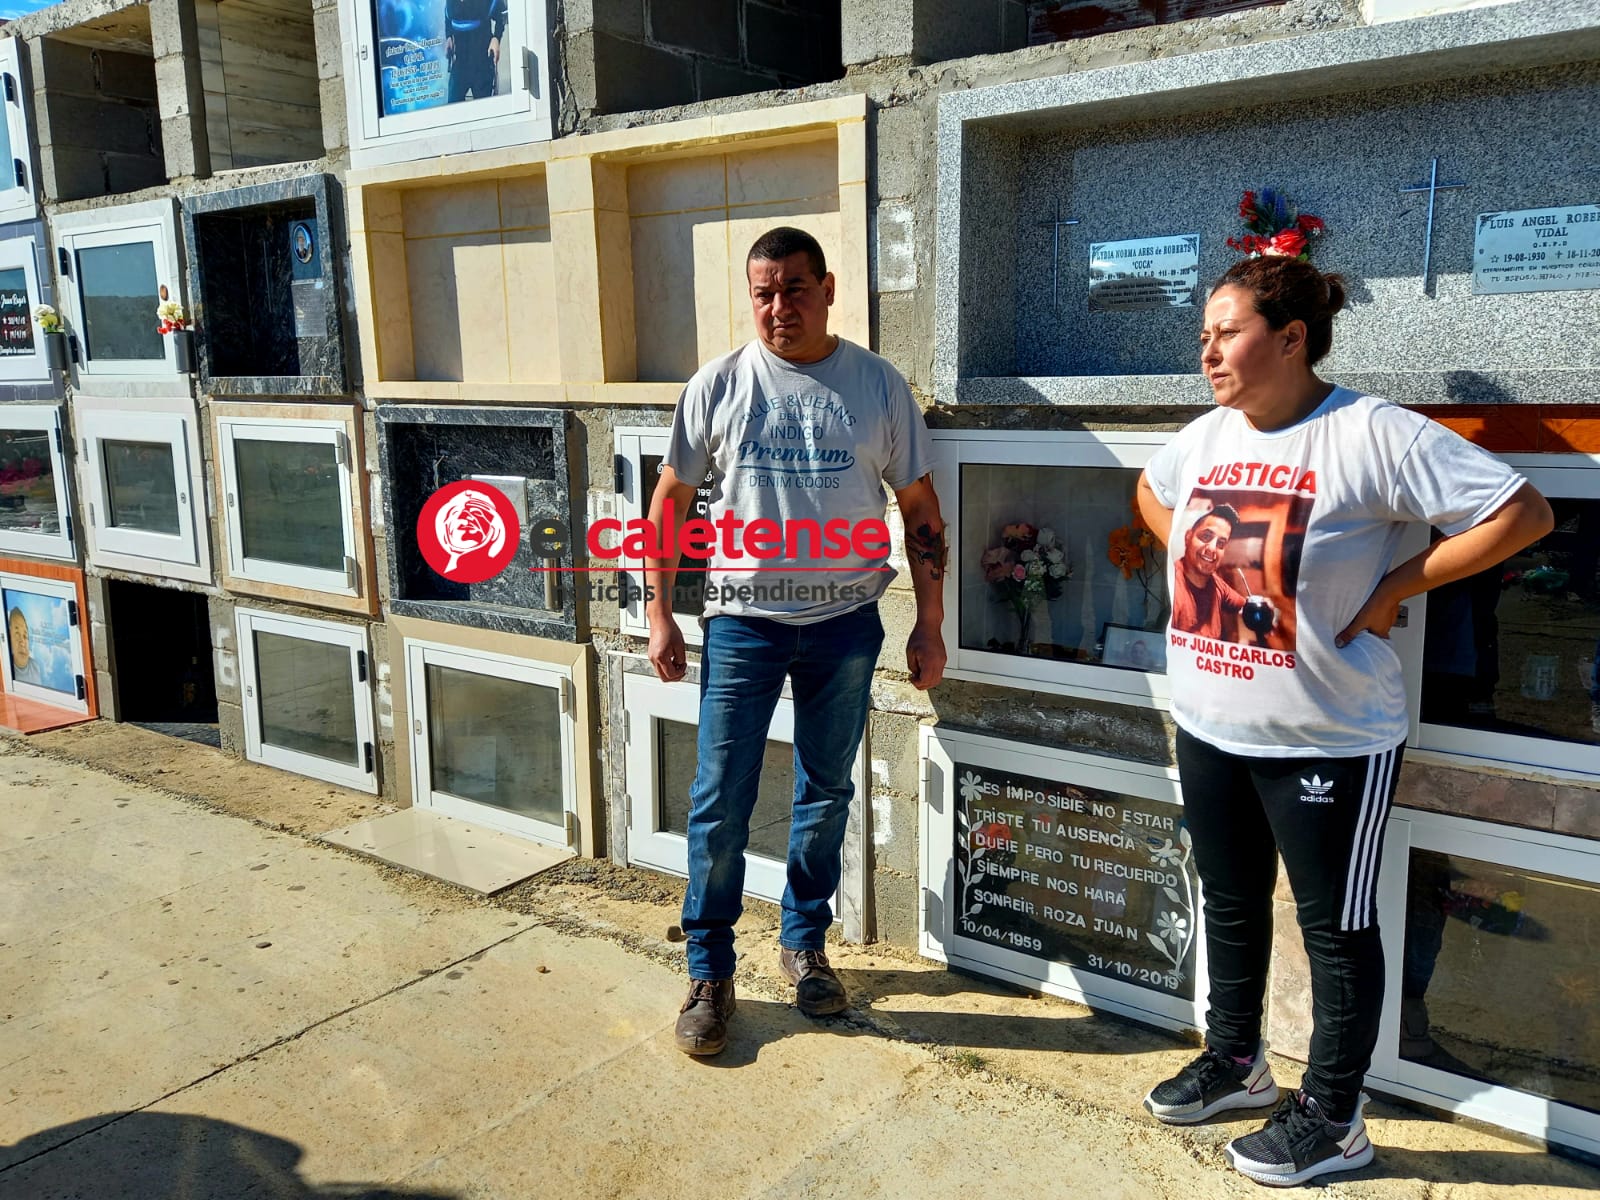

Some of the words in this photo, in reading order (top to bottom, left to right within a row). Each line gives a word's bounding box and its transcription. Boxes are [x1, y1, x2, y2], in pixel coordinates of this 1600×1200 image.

[1490, 218, 1514, 230] LUIS
[1522, 215, 1558, 227] ANGEL
[1535, 227, 1568, 238] VIDAL
[1115, 248, 1137, 259] NORMA
[1138, 246, 1154, 257] ARES
[1155, 245, 1162, 255] de
[1163, 243, 1192, 255] ROBERTS
[786, 394, 800, 407] &
[803, 395, 857, 426] JEANS
[770, 425, 824, 440] INDIGO
[738, 440, 855, 465] Premium
[749, 475, 792, 489] DENIM
[795, 476, 840, 489] GOODS
[1198, 462, 1317, 494] JUSTICIA
[1171, 633, 1188, 648] por
[1190, 638, 1224, 658] JUAN
[1229, 646, 1297, 669] CARLOS
[1196, 657, 1254, 681] CASTRO
[983, 781, 1000, 796] ES
[1092, 803, 1116, 818] NO
[1122, 810, 1174, 831] ESTAR
[1299, 794, 1335, 803] adidas
[1031, 819, 1051, 834] TU
[1025, 844, 1063, 864] PERO
[1070, 854, 1090, 870] TU
[1094, 859, 1178, 887] RECUERDO
[1047, 877, 1079, 895] NOS
[961, 920, 1043, 951] 10/04/1959
[1043, 906, 1086, 928] ROZA
[1093, 918, 1138, 941] JUAN
[1087, 954, 1179, 990] 31/10/2019
